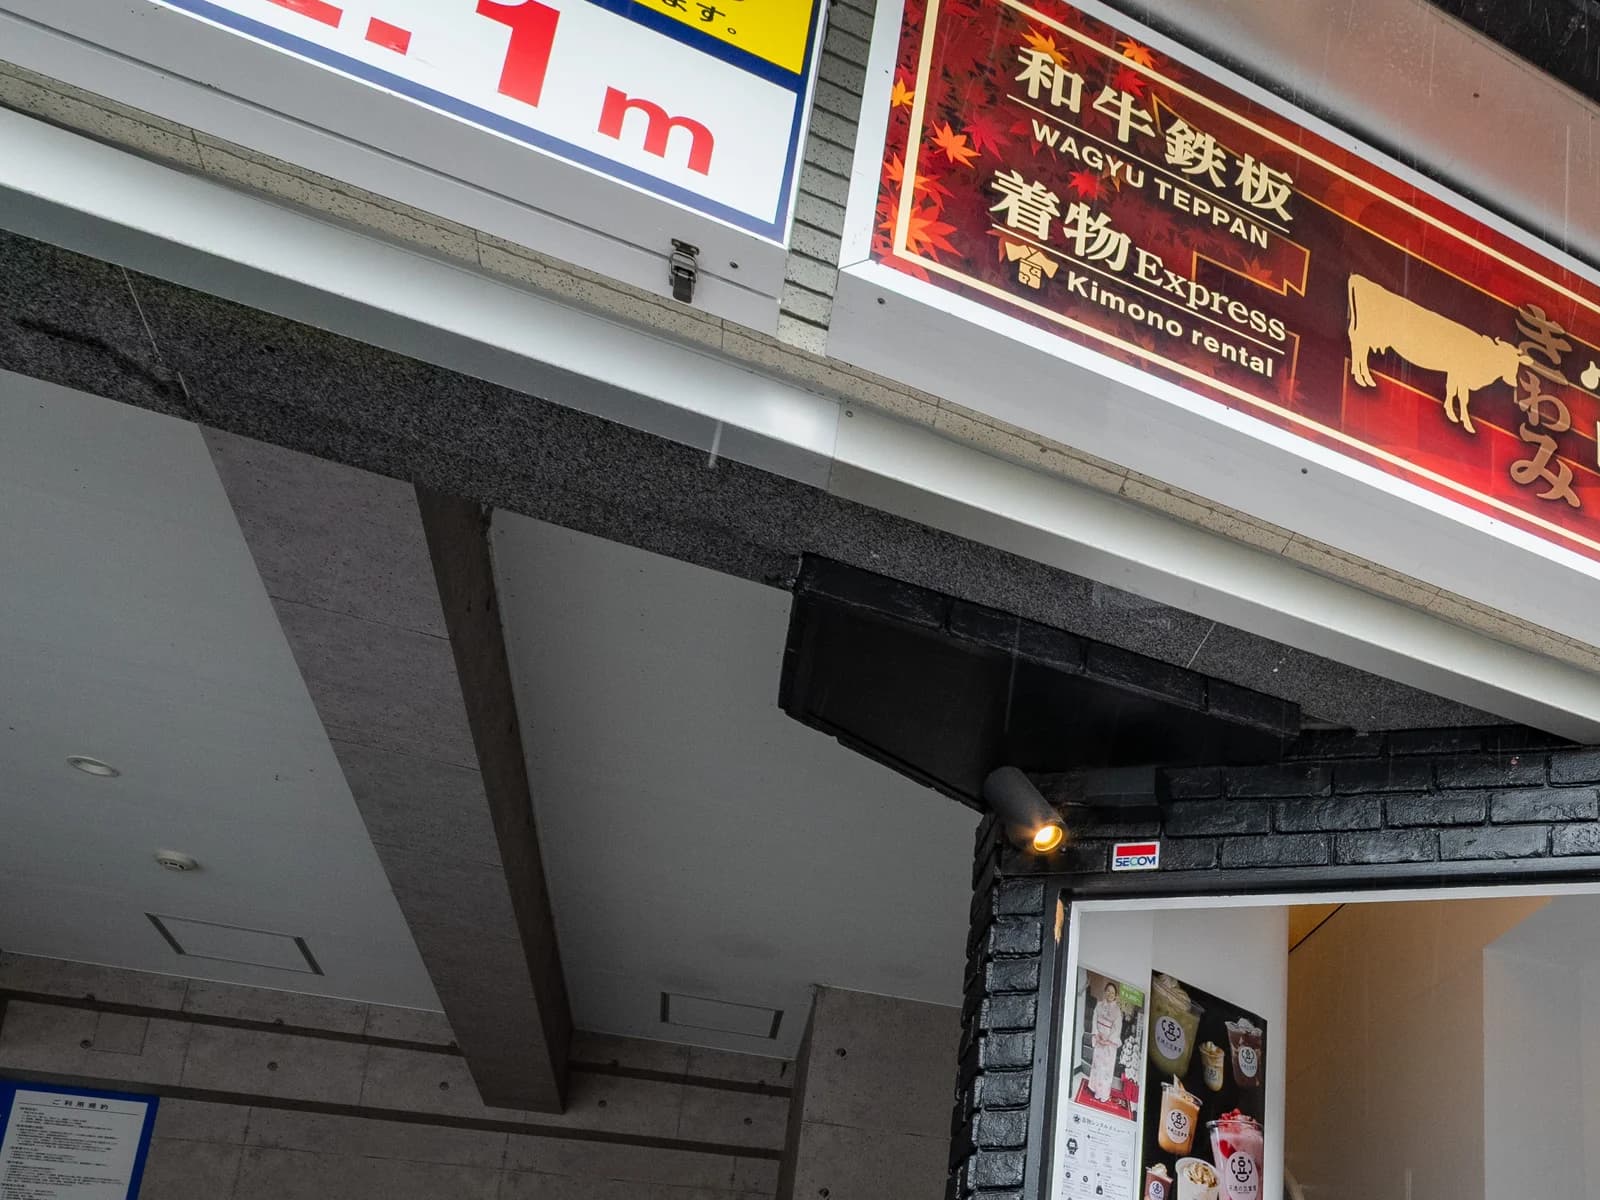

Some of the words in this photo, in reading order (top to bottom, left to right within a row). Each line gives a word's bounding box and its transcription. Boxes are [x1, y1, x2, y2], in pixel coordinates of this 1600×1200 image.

[263, 0, 560, 108] .1
[1013, 46, 1295, 223] 和牛鉄板
[1032, 118, 1145, 189] WAGYU
[1153, 177, 1270, 250] TEPPAN
[1067, 271, 1184, 338] Kimono
[1190, 329, 1274, 378] rental
[1509, 304, 1581, 508] きわみ
[1115, 855, 1156, 867] SECOM
